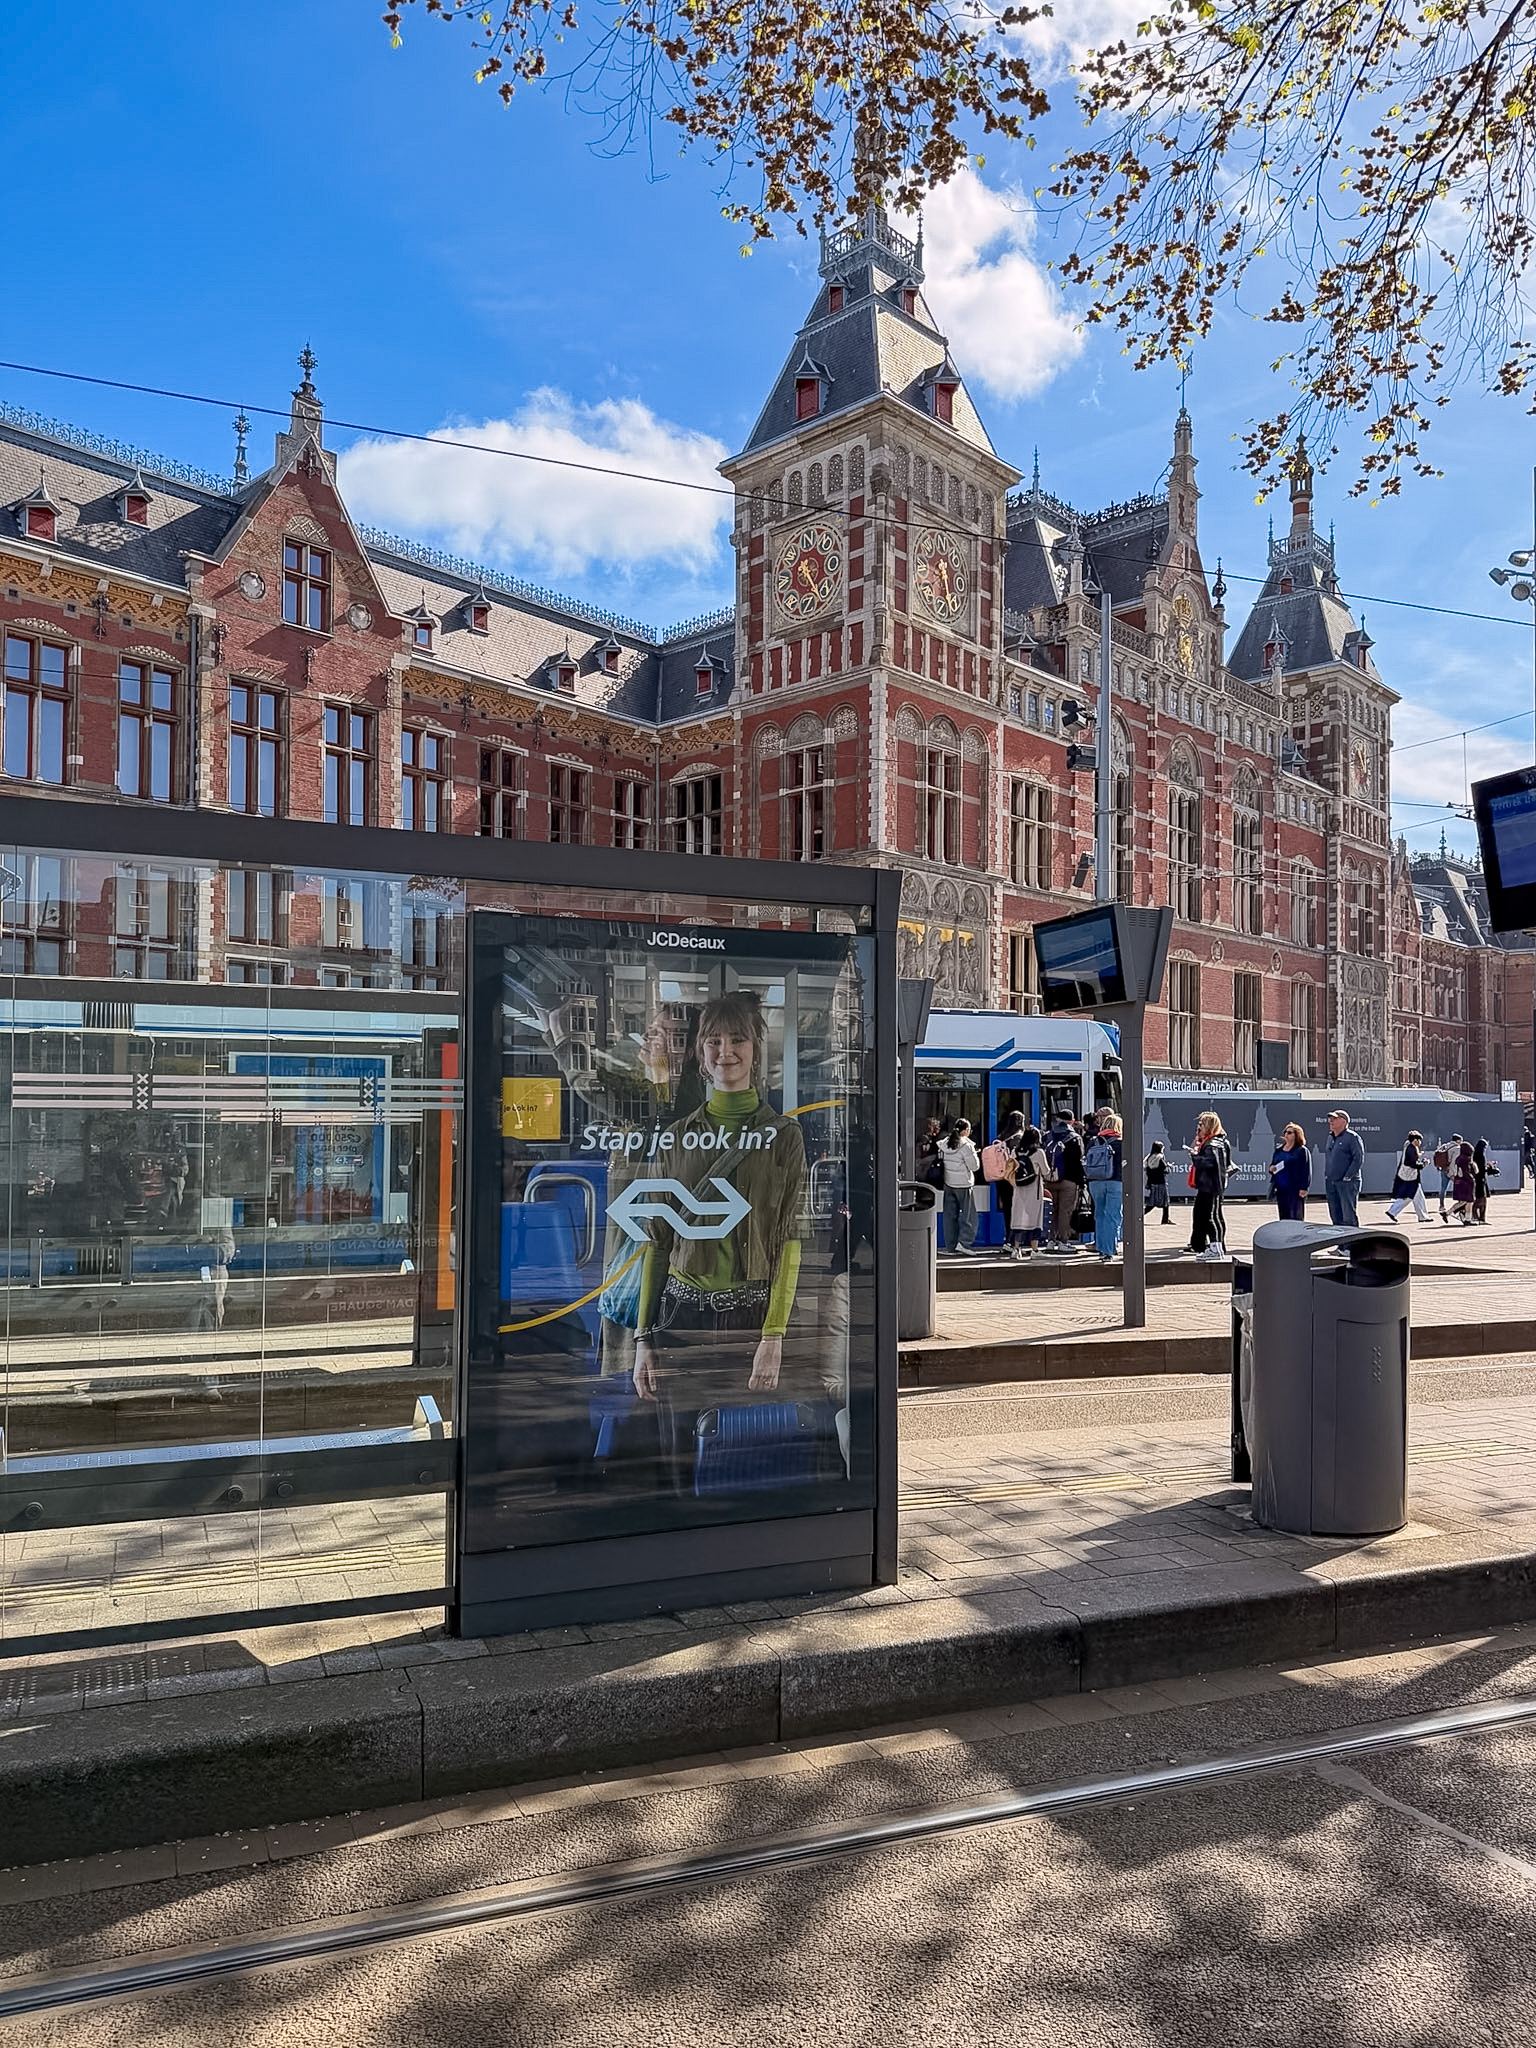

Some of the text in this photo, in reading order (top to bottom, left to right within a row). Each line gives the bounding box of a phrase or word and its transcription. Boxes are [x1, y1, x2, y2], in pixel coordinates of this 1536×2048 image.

[646, 931, 726, 950] JCDecaux
[1151, 1077, 1233, 1093] Amsterdam Centraal
[580, 1125, 778, 1157] Stap je ook in?
